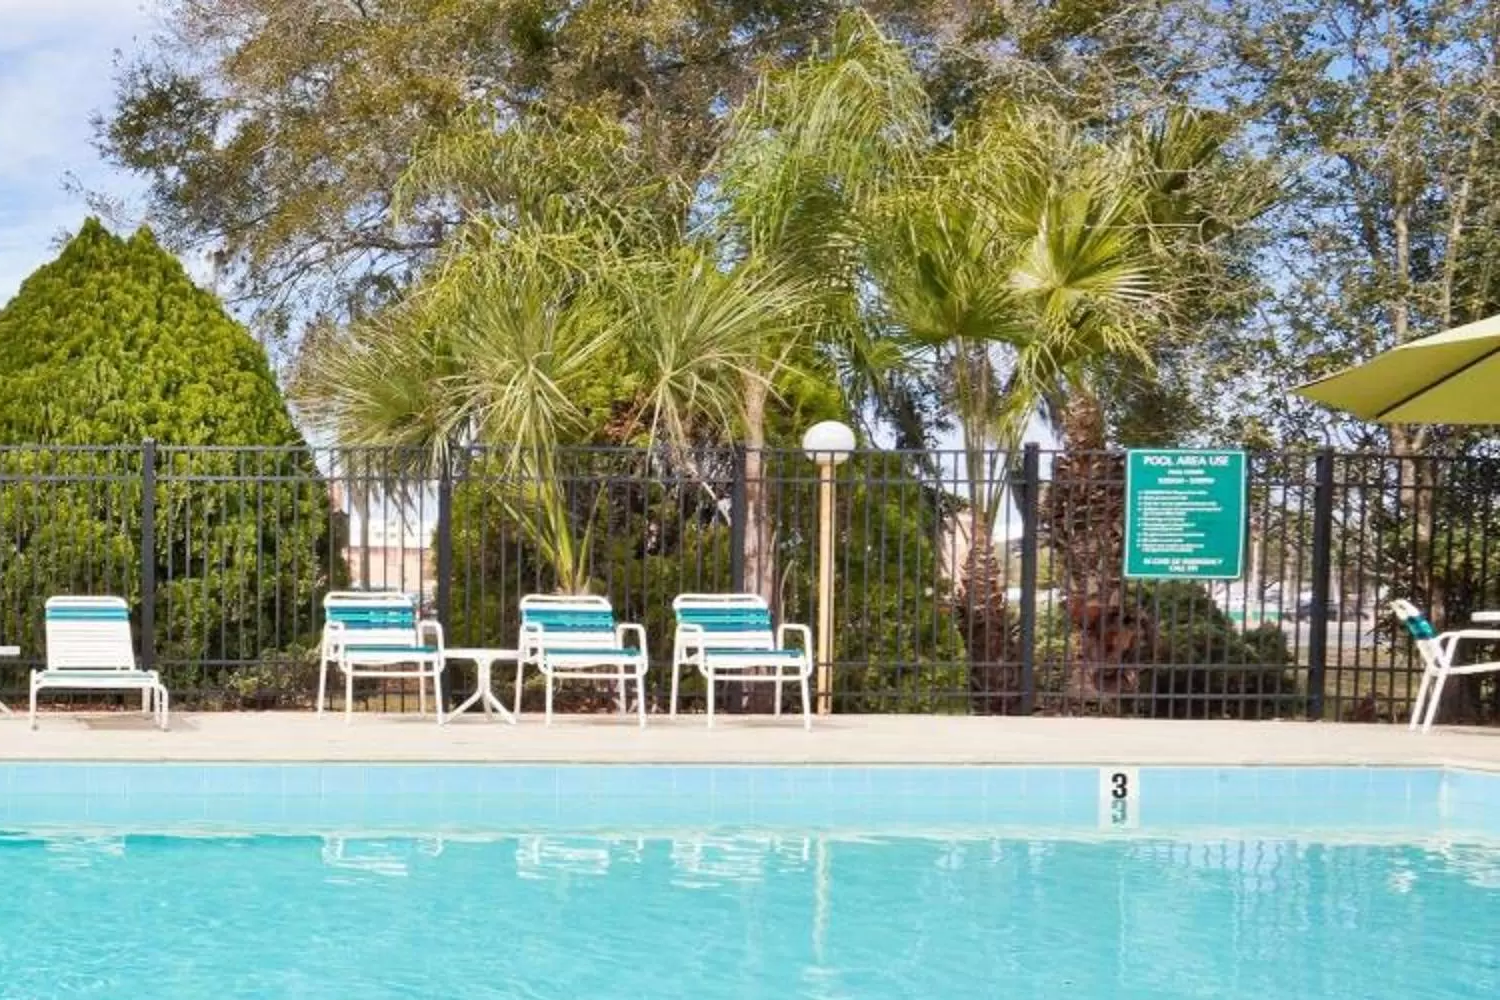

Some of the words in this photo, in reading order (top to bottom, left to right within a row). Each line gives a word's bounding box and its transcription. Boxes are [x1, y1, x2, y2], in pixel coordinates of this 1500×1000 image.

[1143, 455, 1173, 466] POOL
[1176, 455, 1207, 466] AREA
[1209, 455, 1230, 467] USE
[1111, 773, 1128, 799] 3
